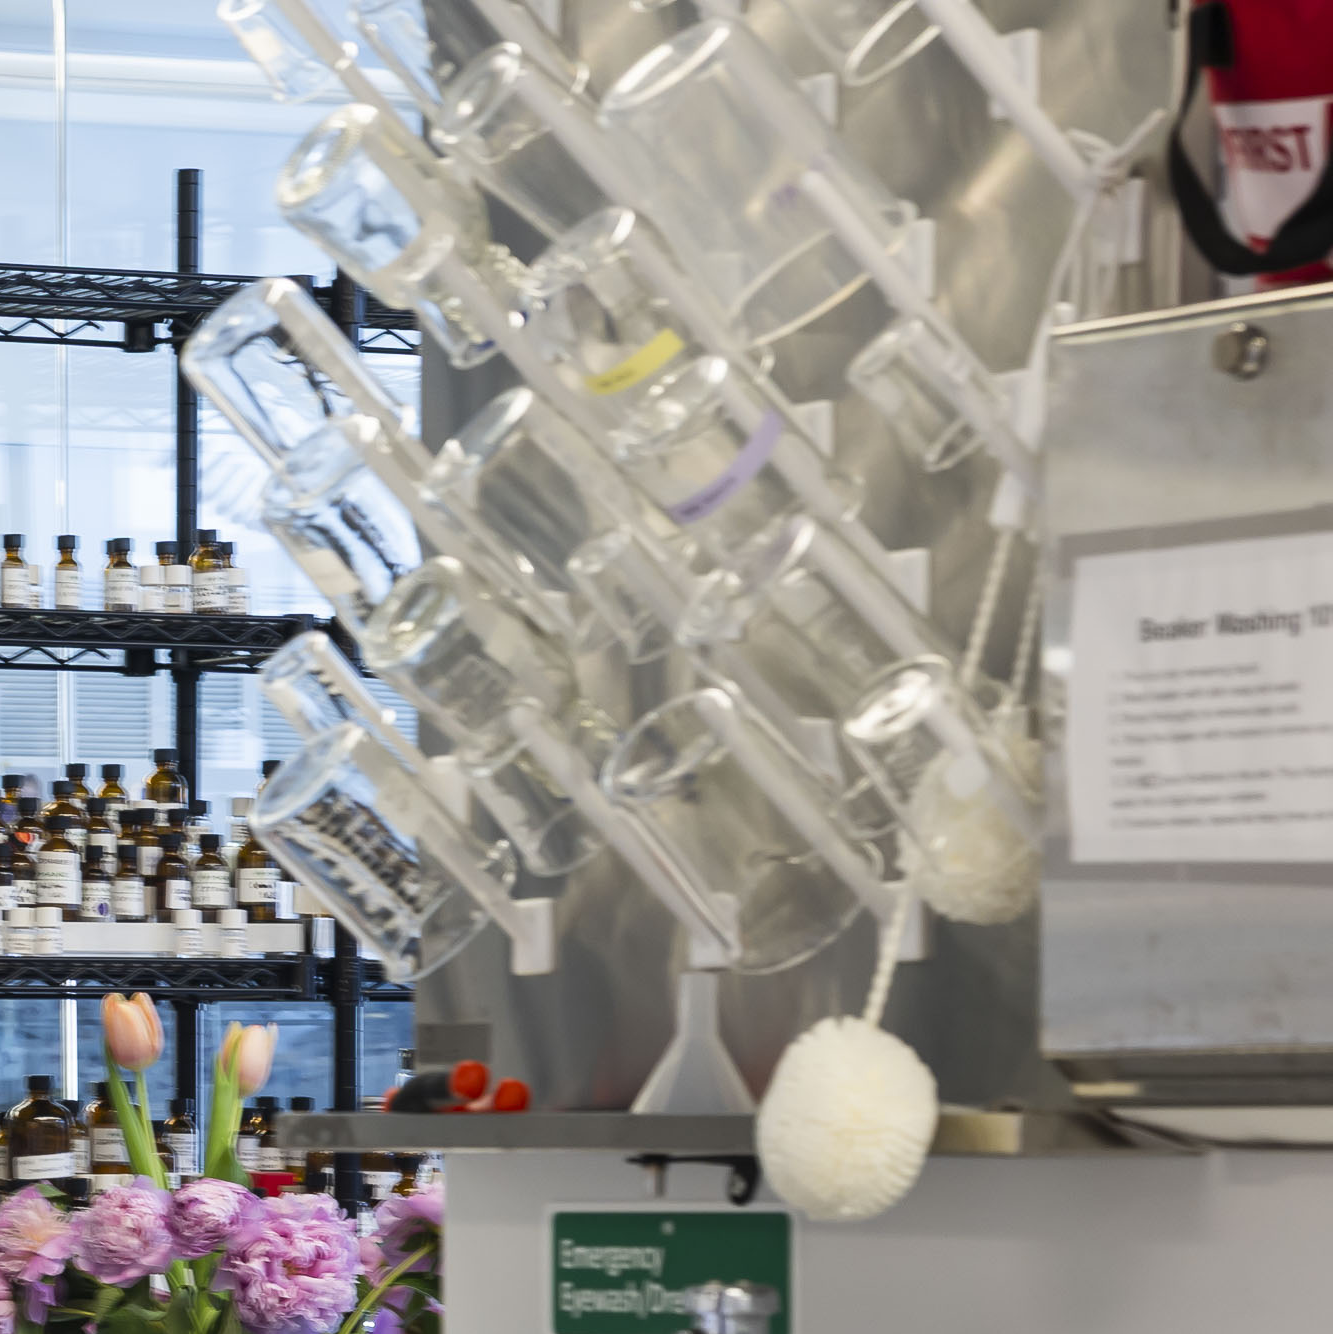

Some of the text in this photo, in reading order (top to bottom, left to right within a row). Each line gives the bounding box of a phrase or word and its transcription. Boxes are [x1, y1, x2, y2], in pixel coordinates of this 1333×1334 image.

[1139, 617, 1206, 642] Beaker
[1215, 611, 1301, 637] Washing
[559, 1238, 665, 1276] Emergency
